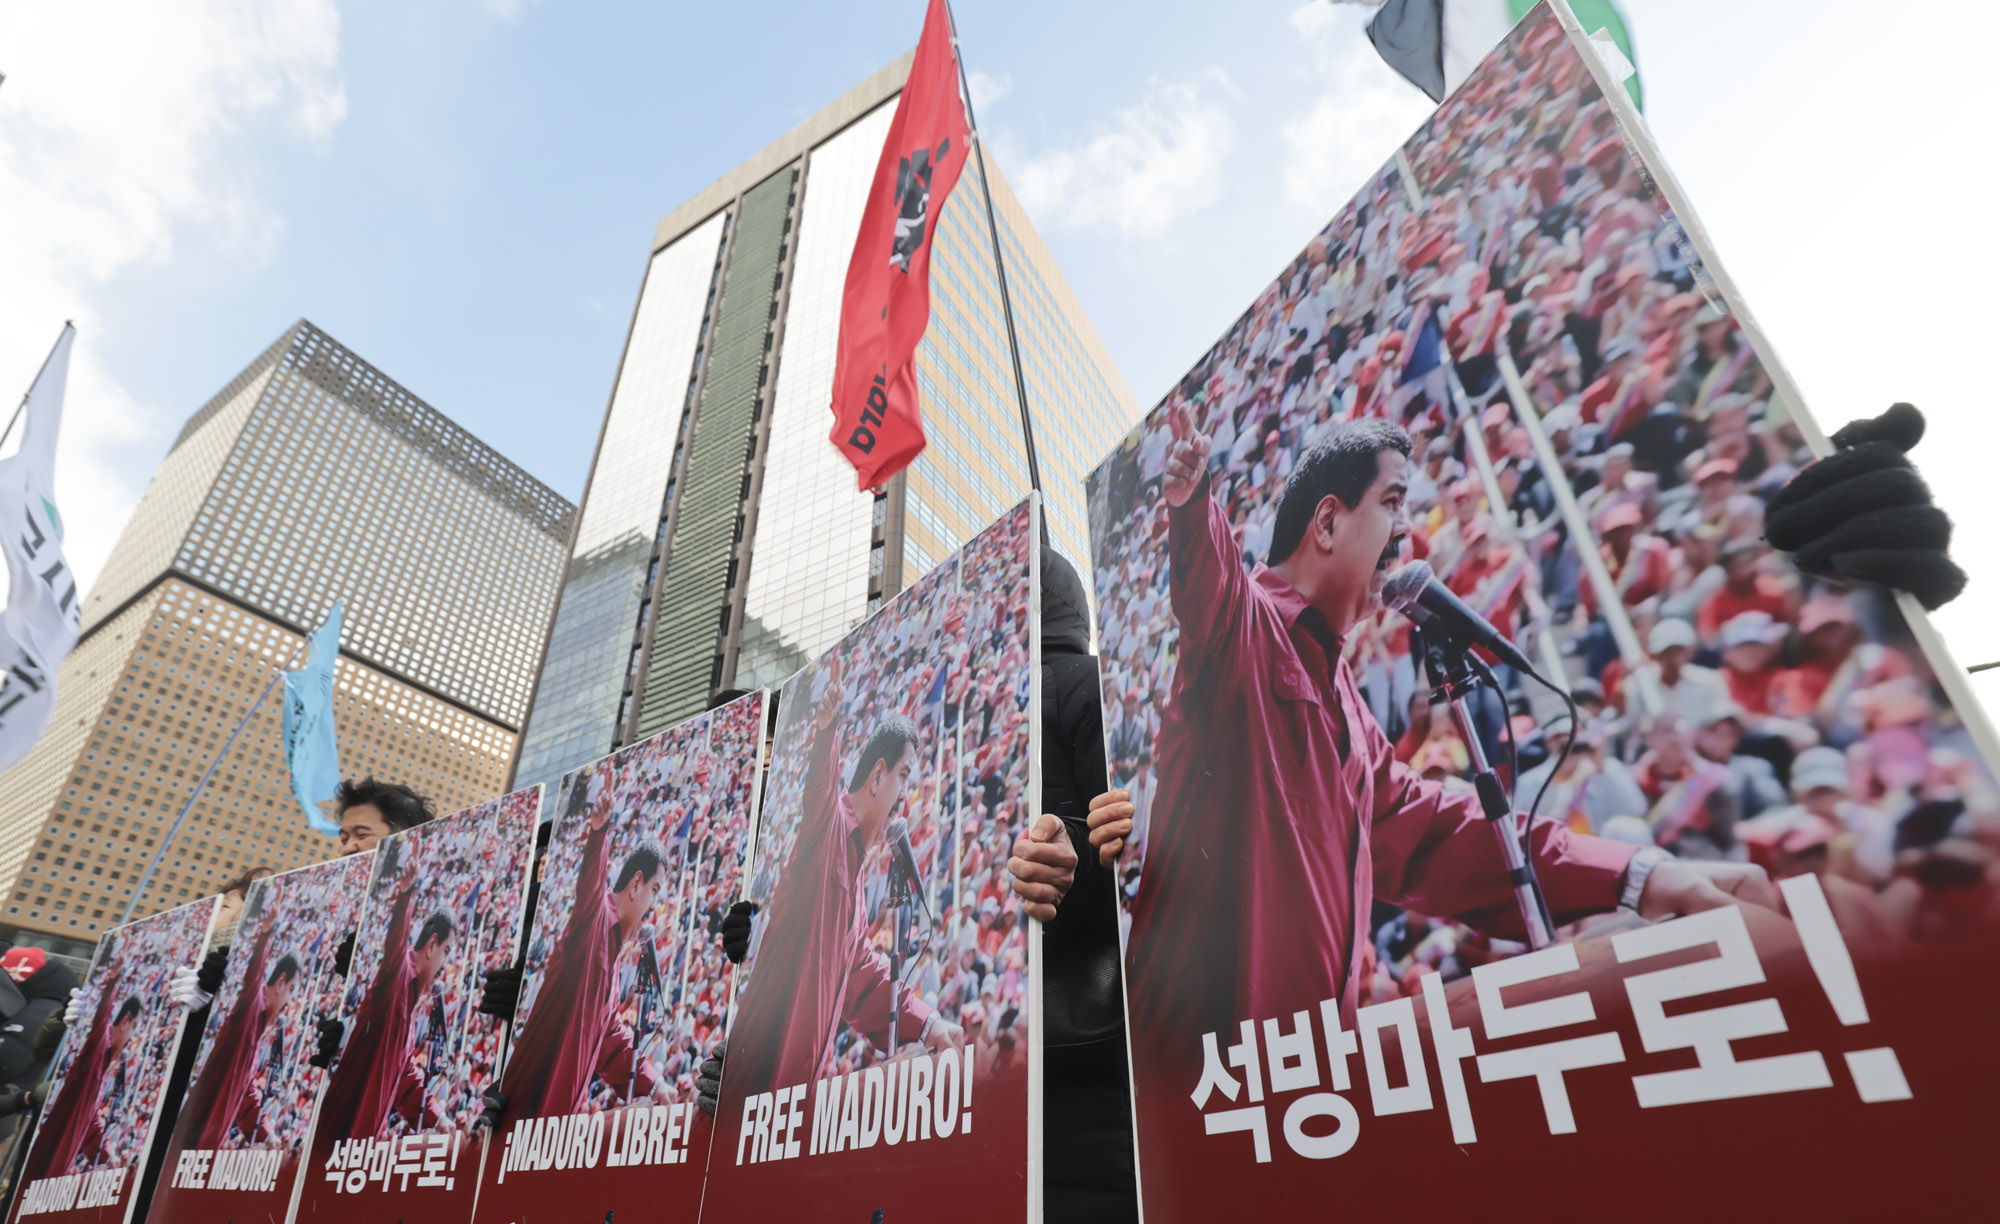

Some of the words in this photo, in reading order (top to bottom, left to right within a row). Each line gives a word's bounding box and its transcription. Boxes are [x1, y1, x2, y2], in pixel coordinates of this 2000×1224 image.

[736, 1083, 807, 1166] FREE
[809, 1044, 974, 1156] MADURO!
[171, 1150, 214, 1190] FREE
[207, 1150, 284, 1192] MADURO!
[497, 1111, 605, 1184] ¡MADURO
[606, 1102, 694, 1167] LIBRE!
[15, 1173, 82, 1224] ¡MADURO
[76, 1167, 128, 1209] LIBRE!
